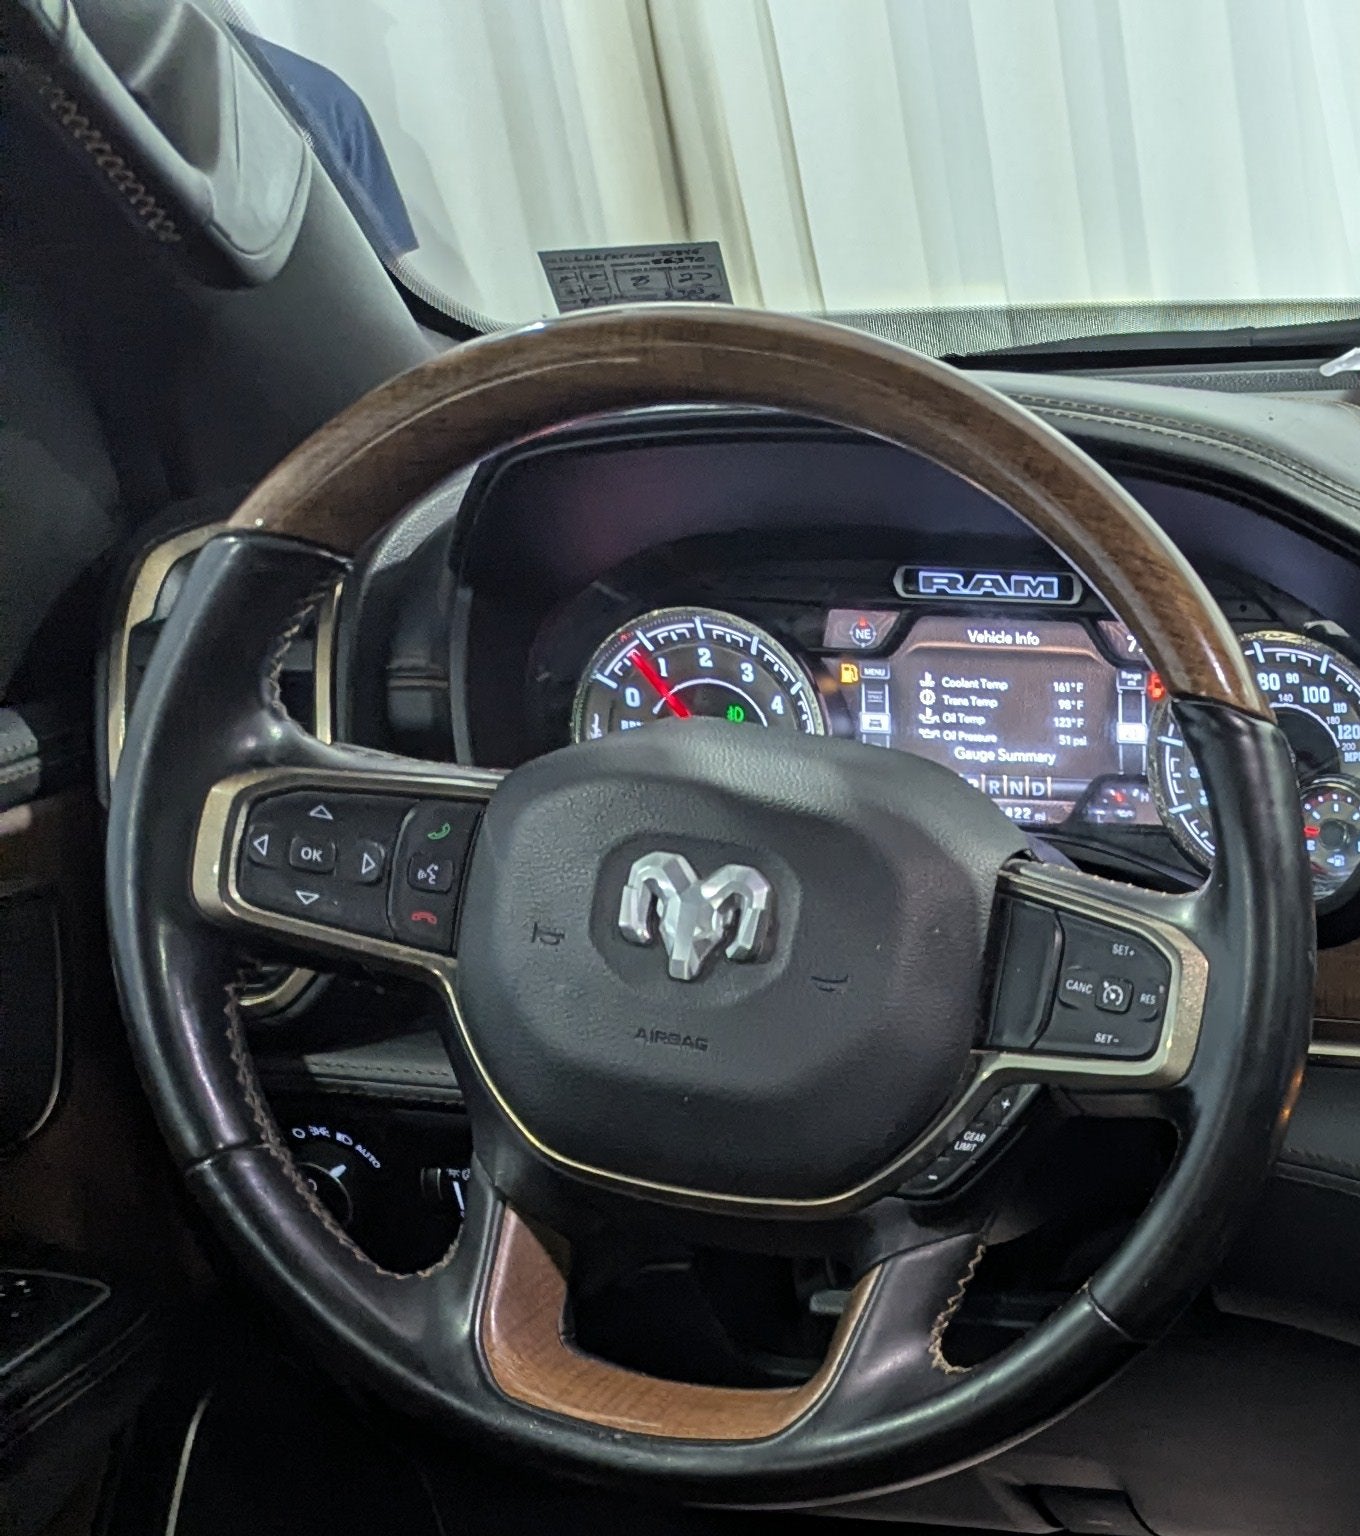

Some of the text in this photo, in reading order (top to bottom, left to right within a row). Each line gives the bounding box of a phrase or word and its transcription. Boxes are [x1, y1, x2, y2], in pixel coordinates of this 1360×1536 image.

[918, 571, 1059, 598] RAM
[856, 628, 872, 640] NE
[967, 629, 1040, 645] Vehicle Info
[698, 648, 713, 667] 2
[658, 658, 668, 677] 1
[740, 663, 754, 682] 3
[864, 668, 886, 676] MENU
[942, 677, 979, 689] Coolant
[980, 678, 1008, 691] Temp
[1286, 673, 1299, 684] 90
[625, 687, 641, 707] 0
[942, 695, 969, 706] Trans
[970, 696, 998, 708] Temp
[1278, 693, 1293, 702] 140
[1302, 686, 1330, 704] 100
[770, 695, 784, 714] 4
[1333, 703, 1347, 714] 110
[942, 713, 956, 723] Oil
[958, 714, 986, 726] Temp
[943, 730, 956, 741] Oil
[958, 731, 997, 743] Pressure
[1073, 736, 1087, 747] psi
[1342, 742, 1356, 751] 200
[954, 746, 1056, 766] Gauge Summary
[989, 782, 1045, 796] R N D
[1307, 841, 1316, 851] E
[300, 847, 322, 863] OK
[1066, 979, 1093, 994] CANC
[1140, 993, 1156, 1004] RES
[633, 1026, 709, 1052] AIRBAG
[963, 1131, 986, 1143] GEAR
[955, 1141, 978, 1152] LIMIT
[355, 1144, 381, 1169] AUTO
